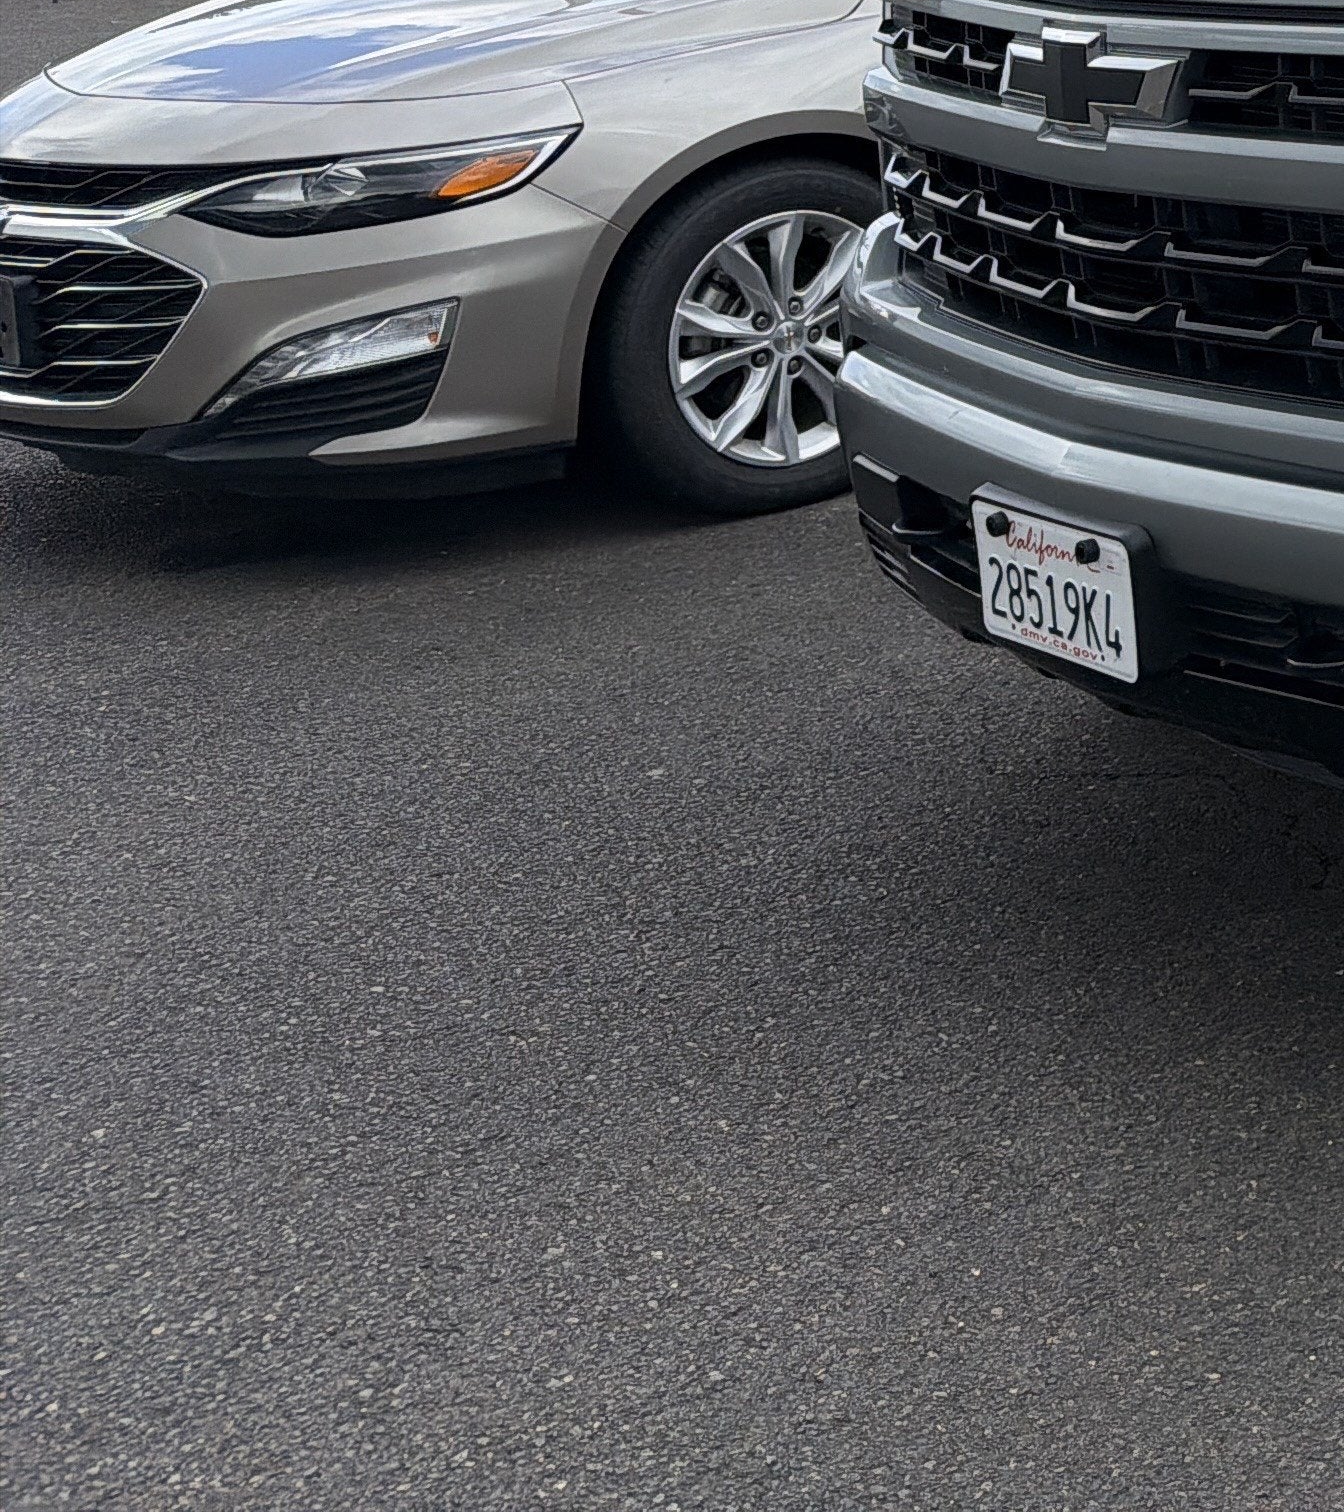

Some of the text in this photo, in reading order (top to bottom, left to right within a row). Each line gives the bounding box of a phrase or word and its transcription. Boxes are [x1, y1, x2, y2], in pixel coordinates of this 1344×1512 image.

[1005, 520, 1101, 573] Californ
[988, 556, 1123, 658] 28519K4
[1021, 628, 1098, 660] dmv.ca.gov
